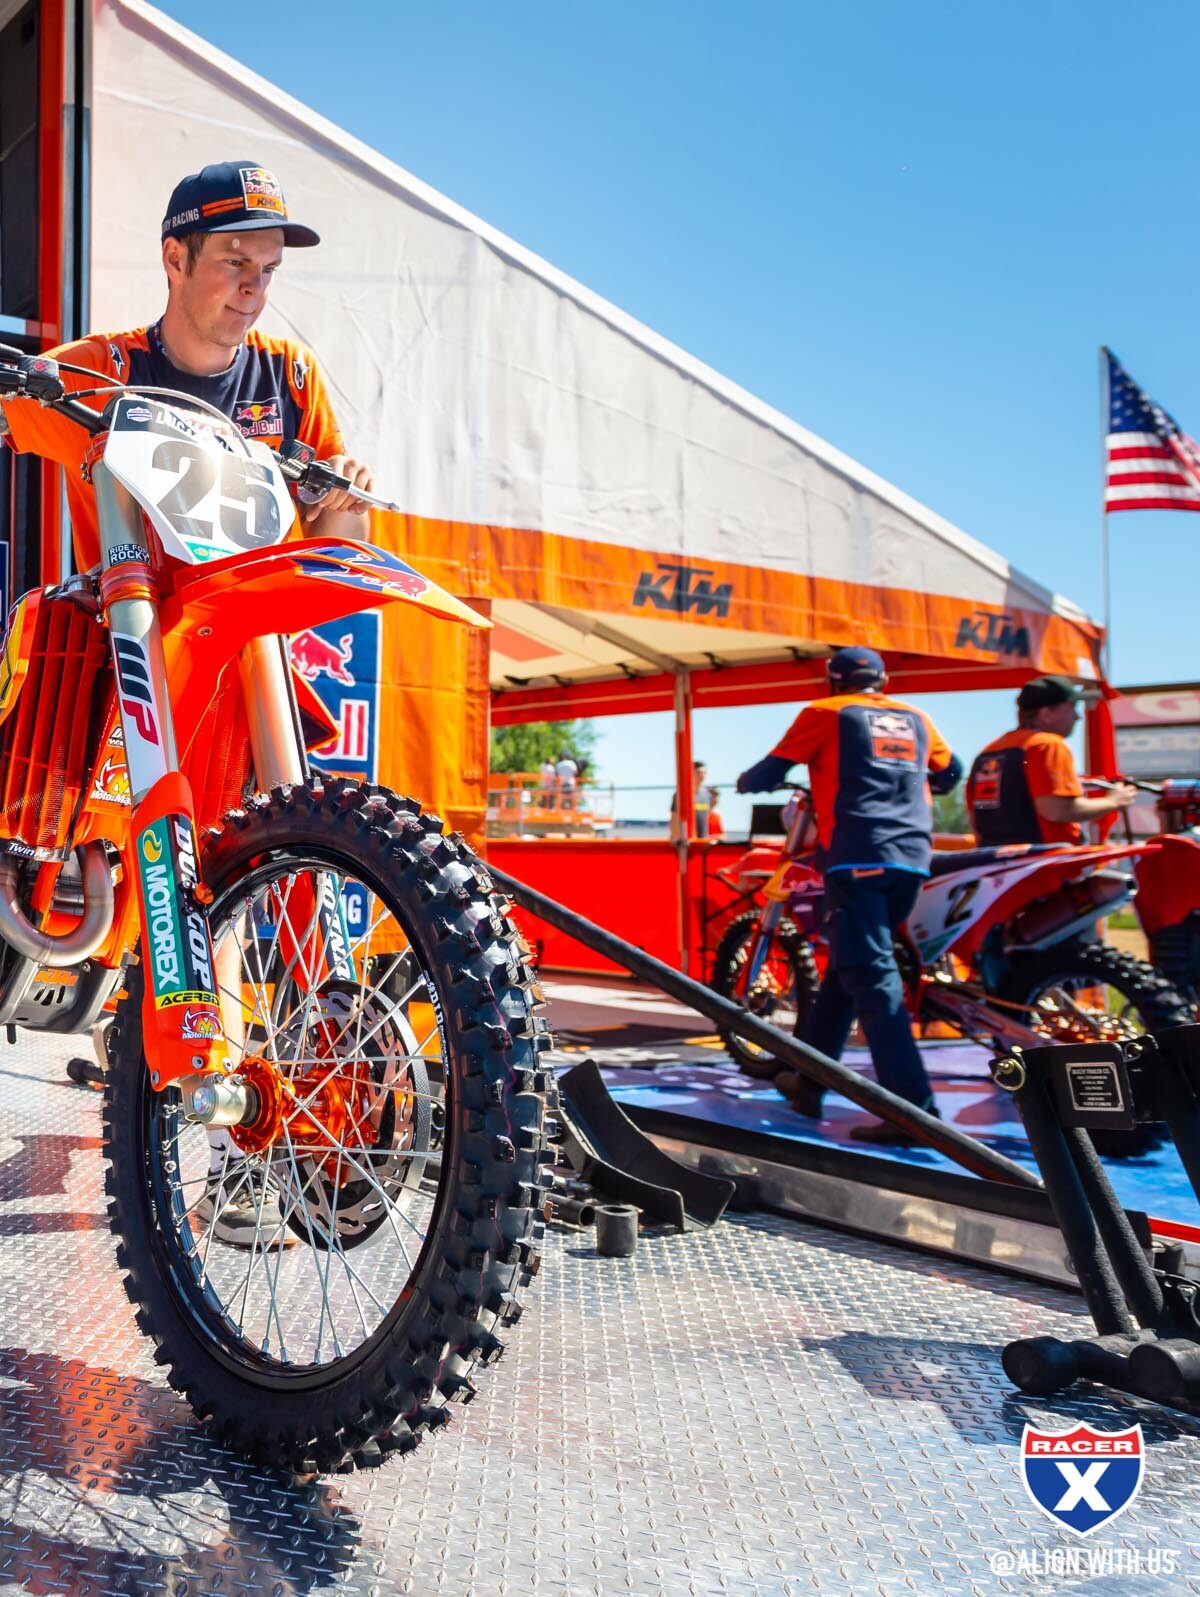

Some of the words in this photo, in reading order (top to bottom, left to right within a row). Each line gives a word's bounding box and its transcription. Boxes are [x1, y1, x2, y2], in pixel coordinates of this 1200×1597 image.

[172, 208, 200, 229] RACING
[258, 418, 283, 434] Bull
[152, 441, 281, 550] 25
[109, 544, 130, 557] RIDE
[110, 549, 150, 564] ROCKY
[632, 563, 733, 618] KTM
[954, 610, 1031, 657] KTM
[145, 863, 180, 991] MOTOREX
[173, 820, 212, 991] DULOP
[945, 880, 981, 928] 2
[33, 968, 79, 986] KTM
